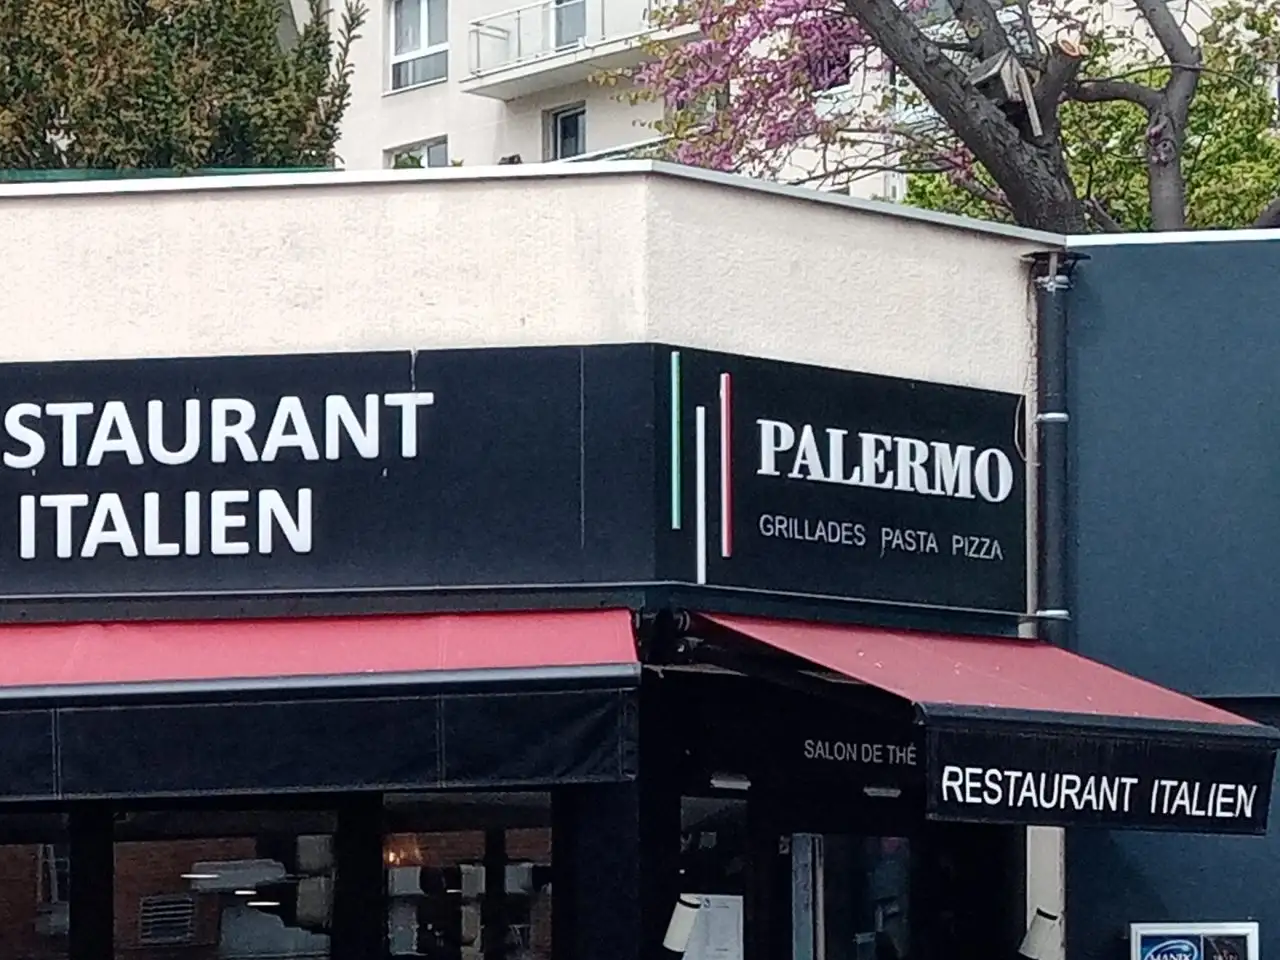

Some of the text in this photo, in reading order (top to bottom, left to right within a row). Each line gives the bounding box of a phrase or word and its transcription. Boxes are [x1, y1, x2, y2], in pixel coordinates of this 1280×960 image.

[756, 418, 1014, 503] PALERMO
[19, 486, 313, 560] ITALIEN
[759, 513, 1004, 561] GRILLADES PASTA PIZZA
[804, 739, 917, 766] SALON DE THÉ
[940, 765, 1258, 818] RESTAURANT ITALIEN
